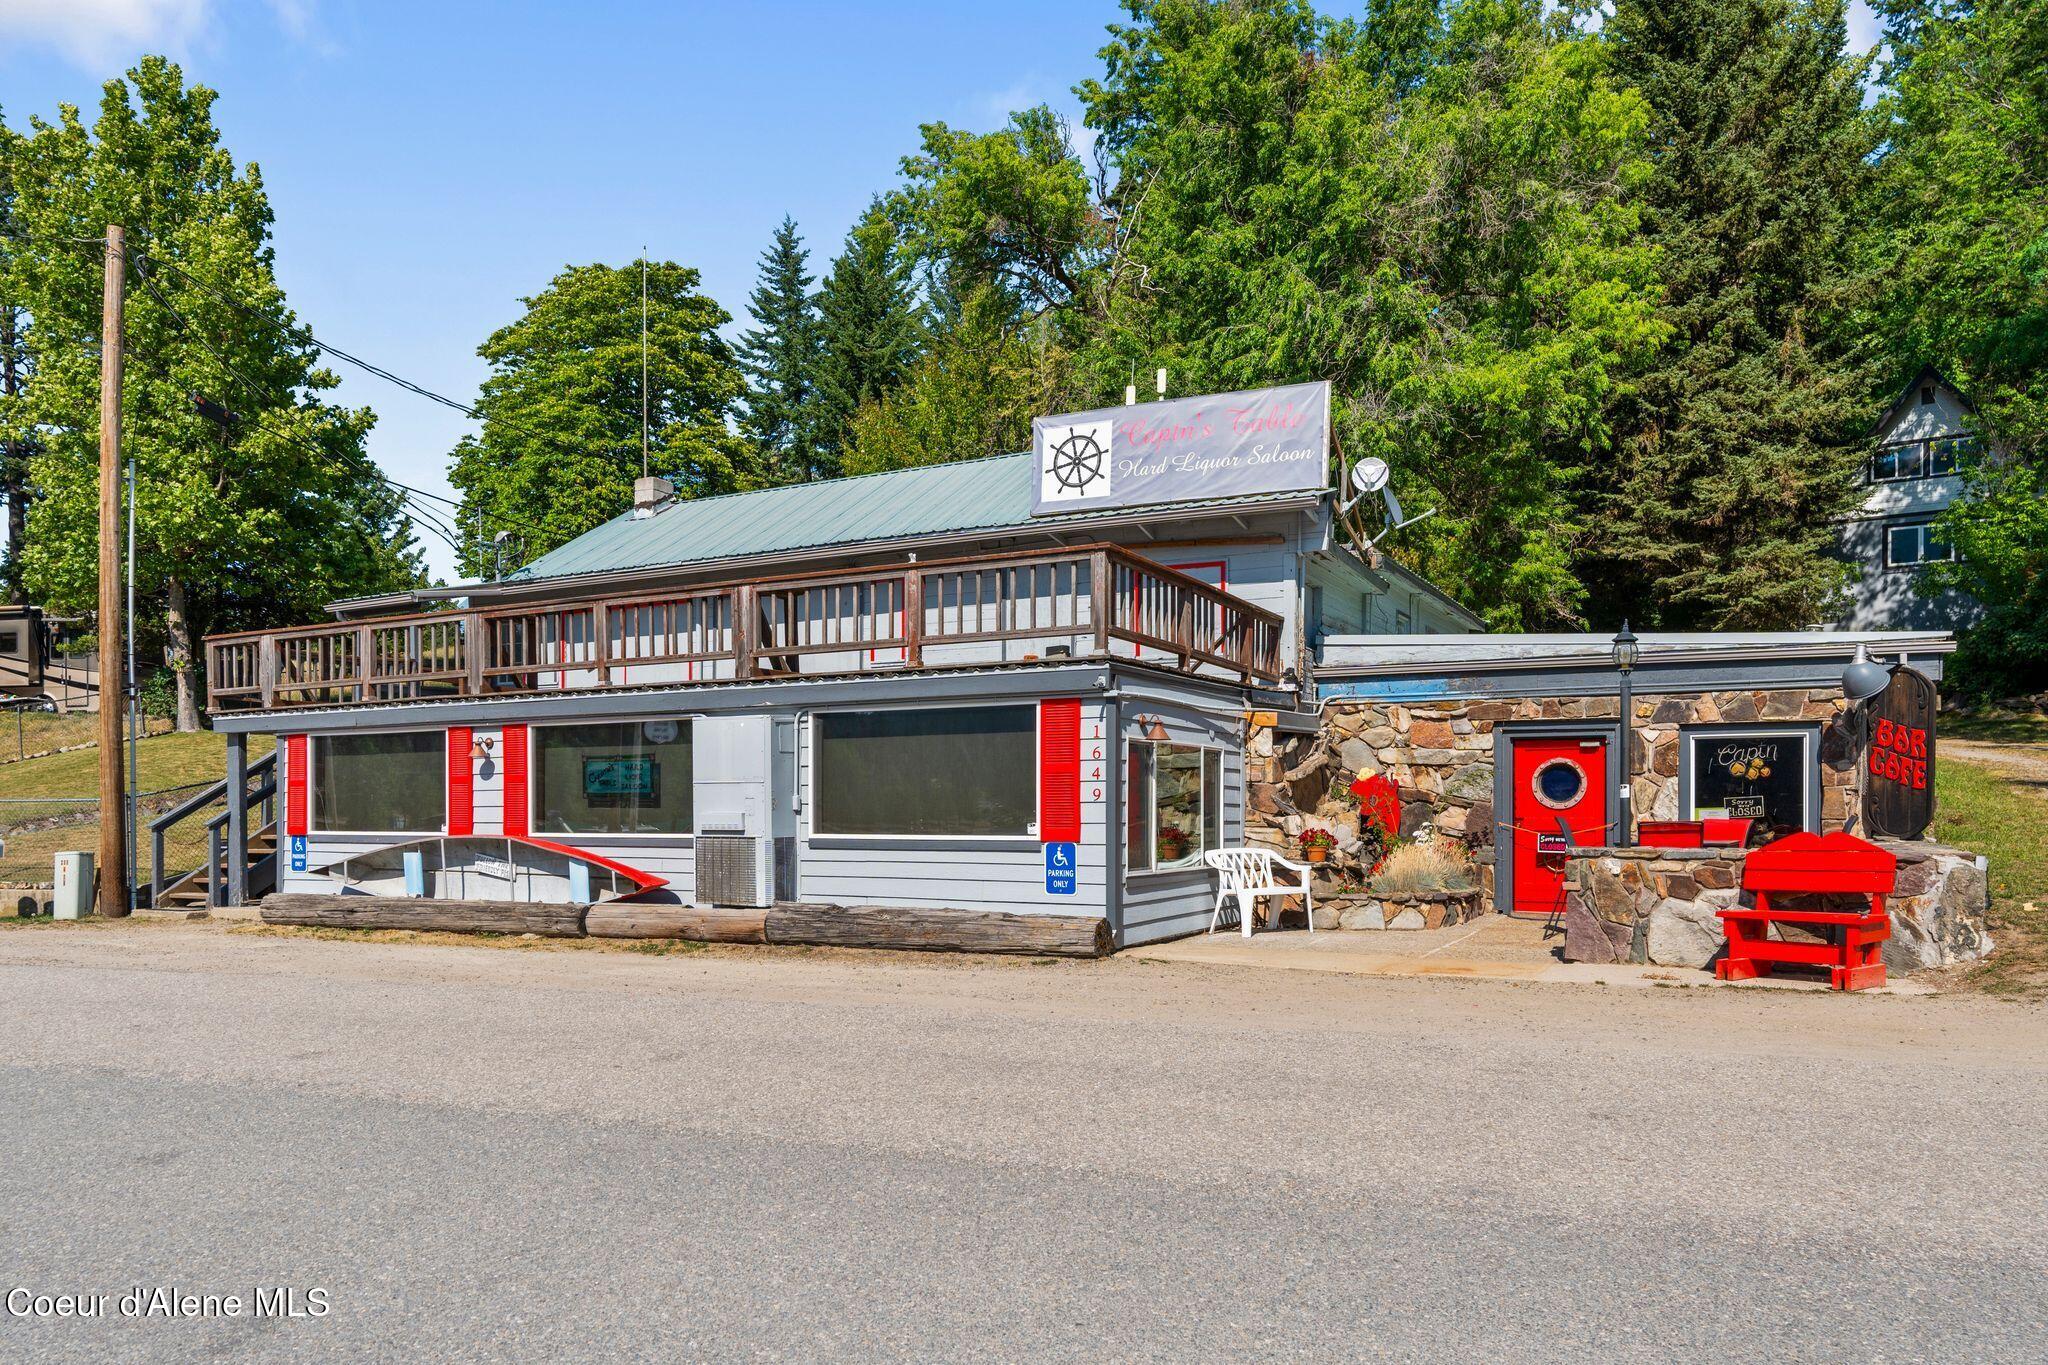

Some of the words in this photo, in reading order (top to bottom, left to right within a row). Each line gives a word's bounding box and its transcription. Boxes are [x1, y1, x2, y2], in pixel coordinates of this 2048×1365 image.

[1118, 456, 1169, 478] Hard
[1172, 451, 1241, 476] Liquor
[1247, 443, 1315, 465] Saloon
[1876, 717, 1927, 758] BAR
[1869, 746, 1927, 789] CAFE
[1728, 805, 1762, 817] CLOSED
[1047, 869, 1074, 878] PARKING
[1053, 880, 1069, 888] ONLY
